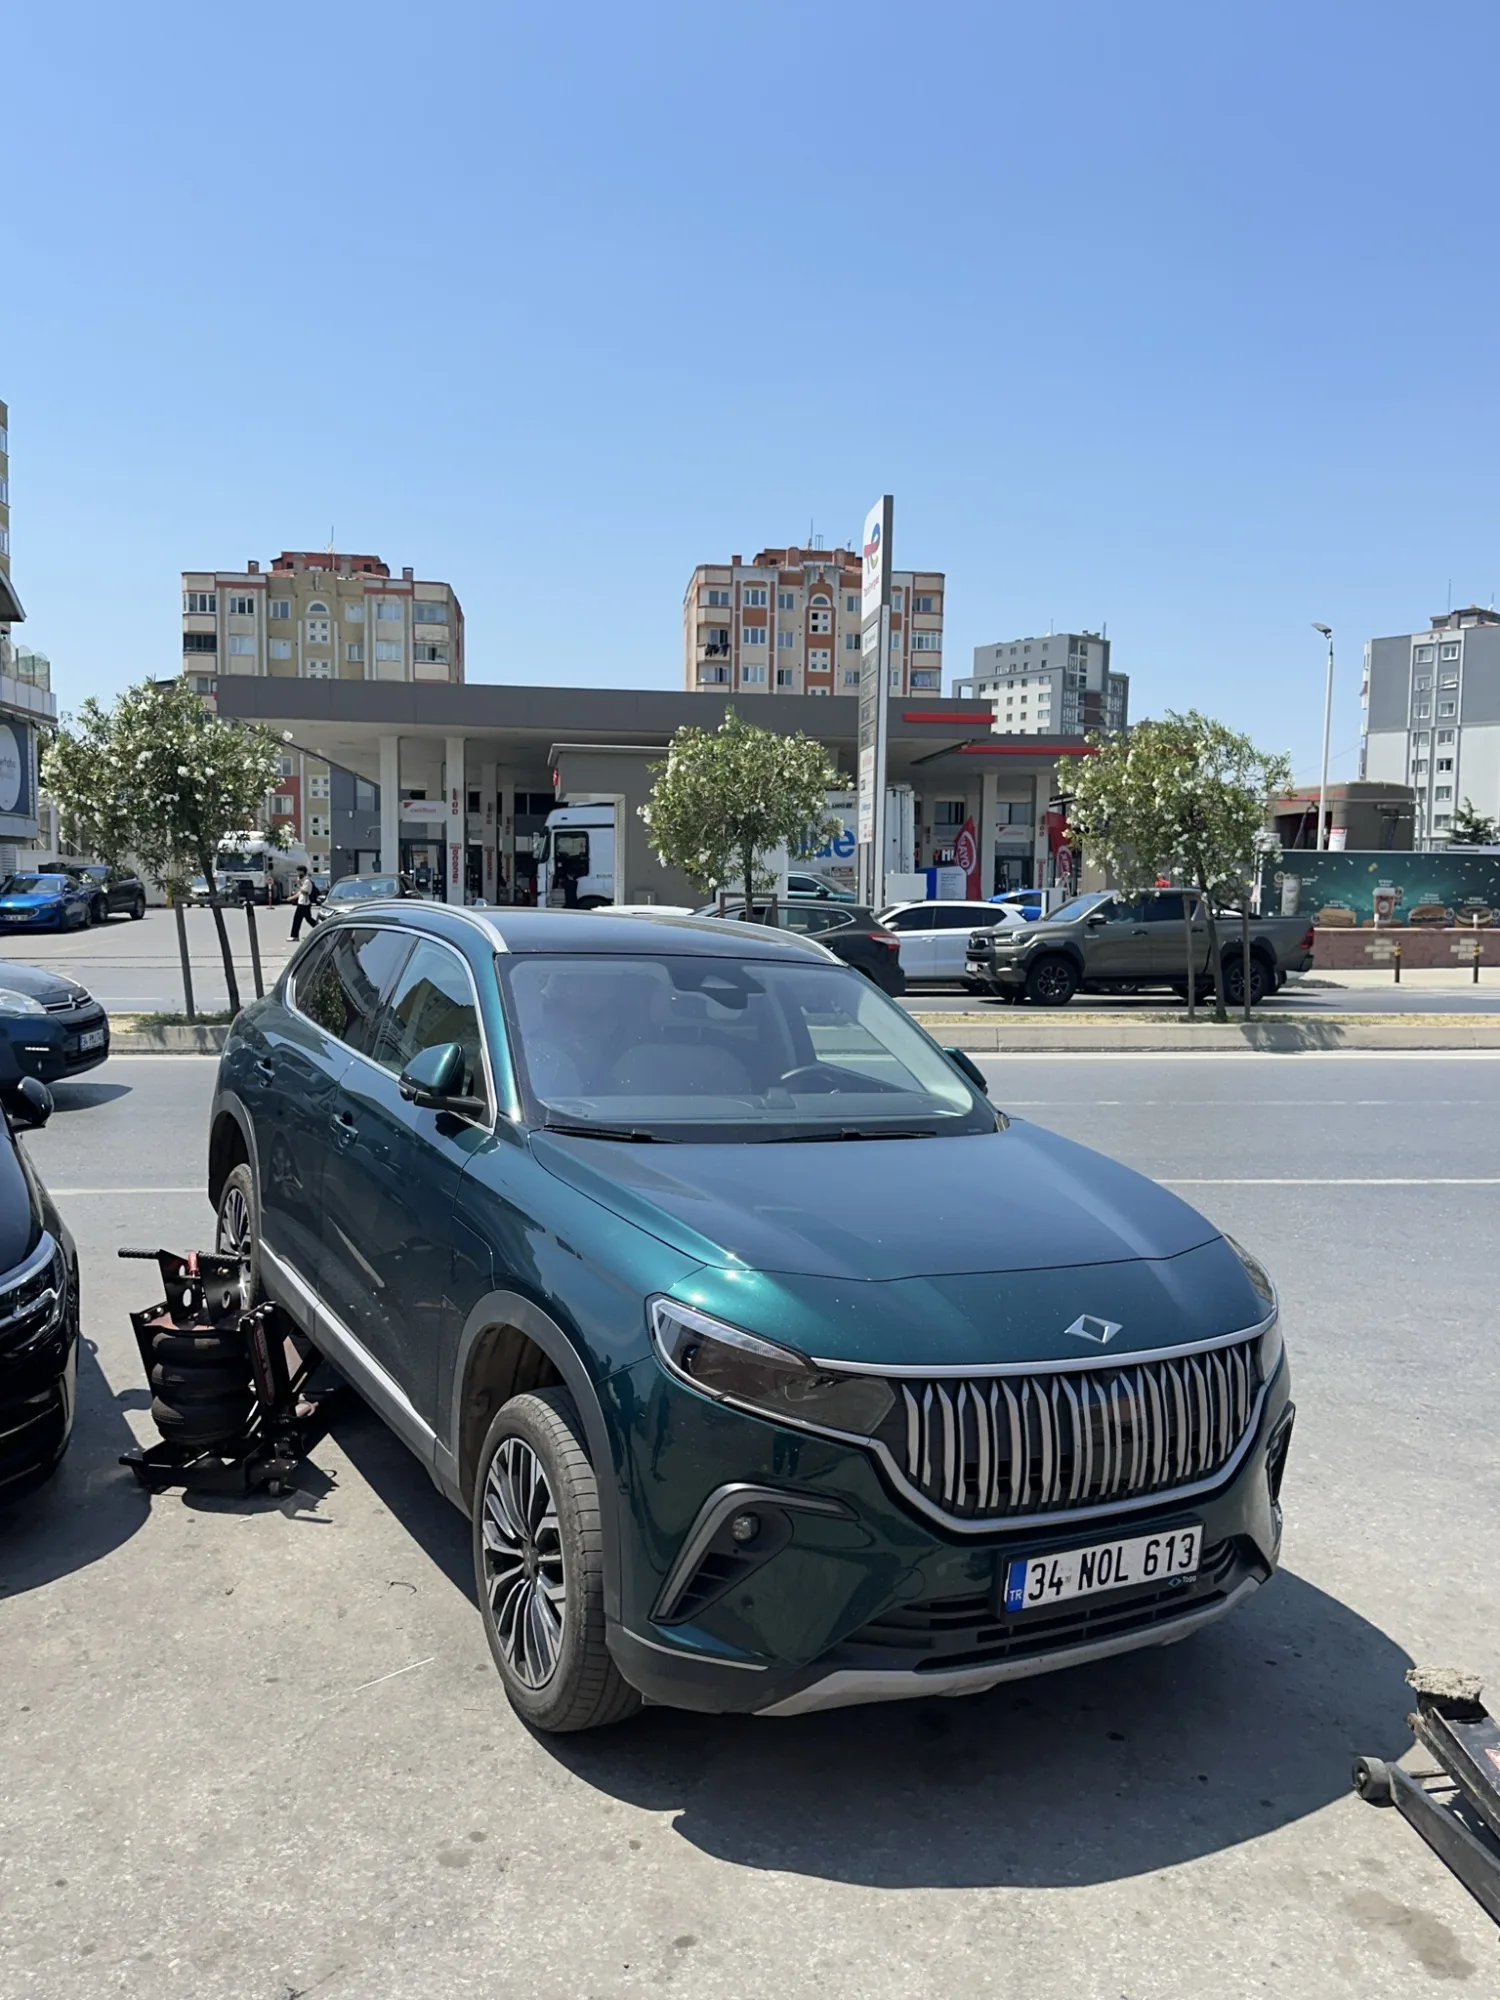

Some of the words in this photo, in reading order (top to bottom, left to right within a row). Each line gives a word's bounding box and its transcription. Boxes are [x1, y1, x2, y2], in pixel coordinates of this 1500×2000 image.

[1028, 1560, 1064, 1601] 34
[1078, 1546, 1129, 1591] NOL
[1143, 1533, 1195, 1576] 613
[1182, 1575, 1197, 1583] Togg
[1010, 1589, 1023, 1600] TR
